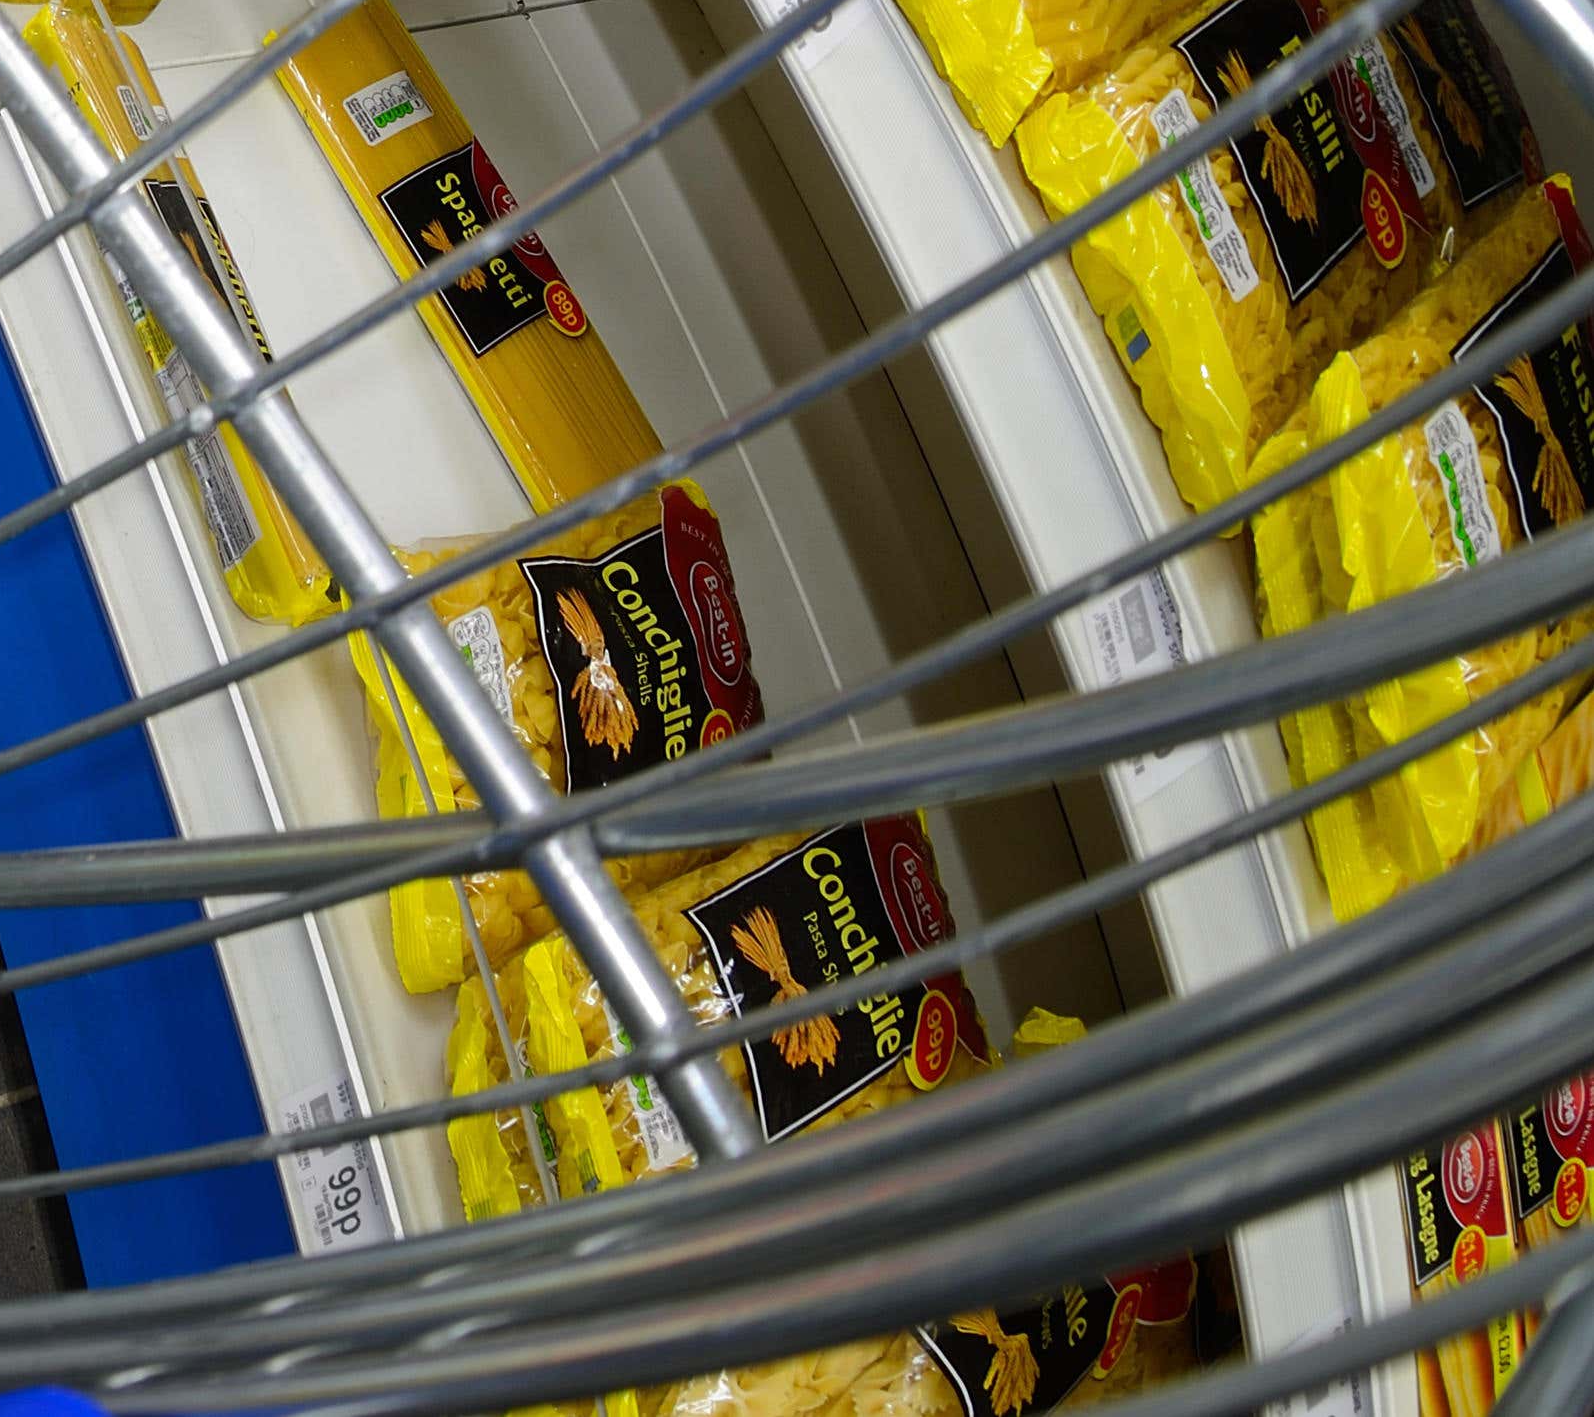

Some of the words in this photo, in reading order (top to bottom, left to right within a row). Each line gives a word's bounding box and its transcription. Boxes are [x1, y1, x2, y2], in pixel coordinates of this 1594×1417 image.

[436, 171, 528, 310] Spagetti
[1367, 189, 1395, 250] 99p
[550, 289, 579, 328] 89p
[703, 574, 736, 669] Best-in
[601, 560, 686, 761] Conchiglie
[633, 650, 652, 707] Shells
[803, 911, 827, 959] Pasta
[926, 1008, 945, 1071] 99p
